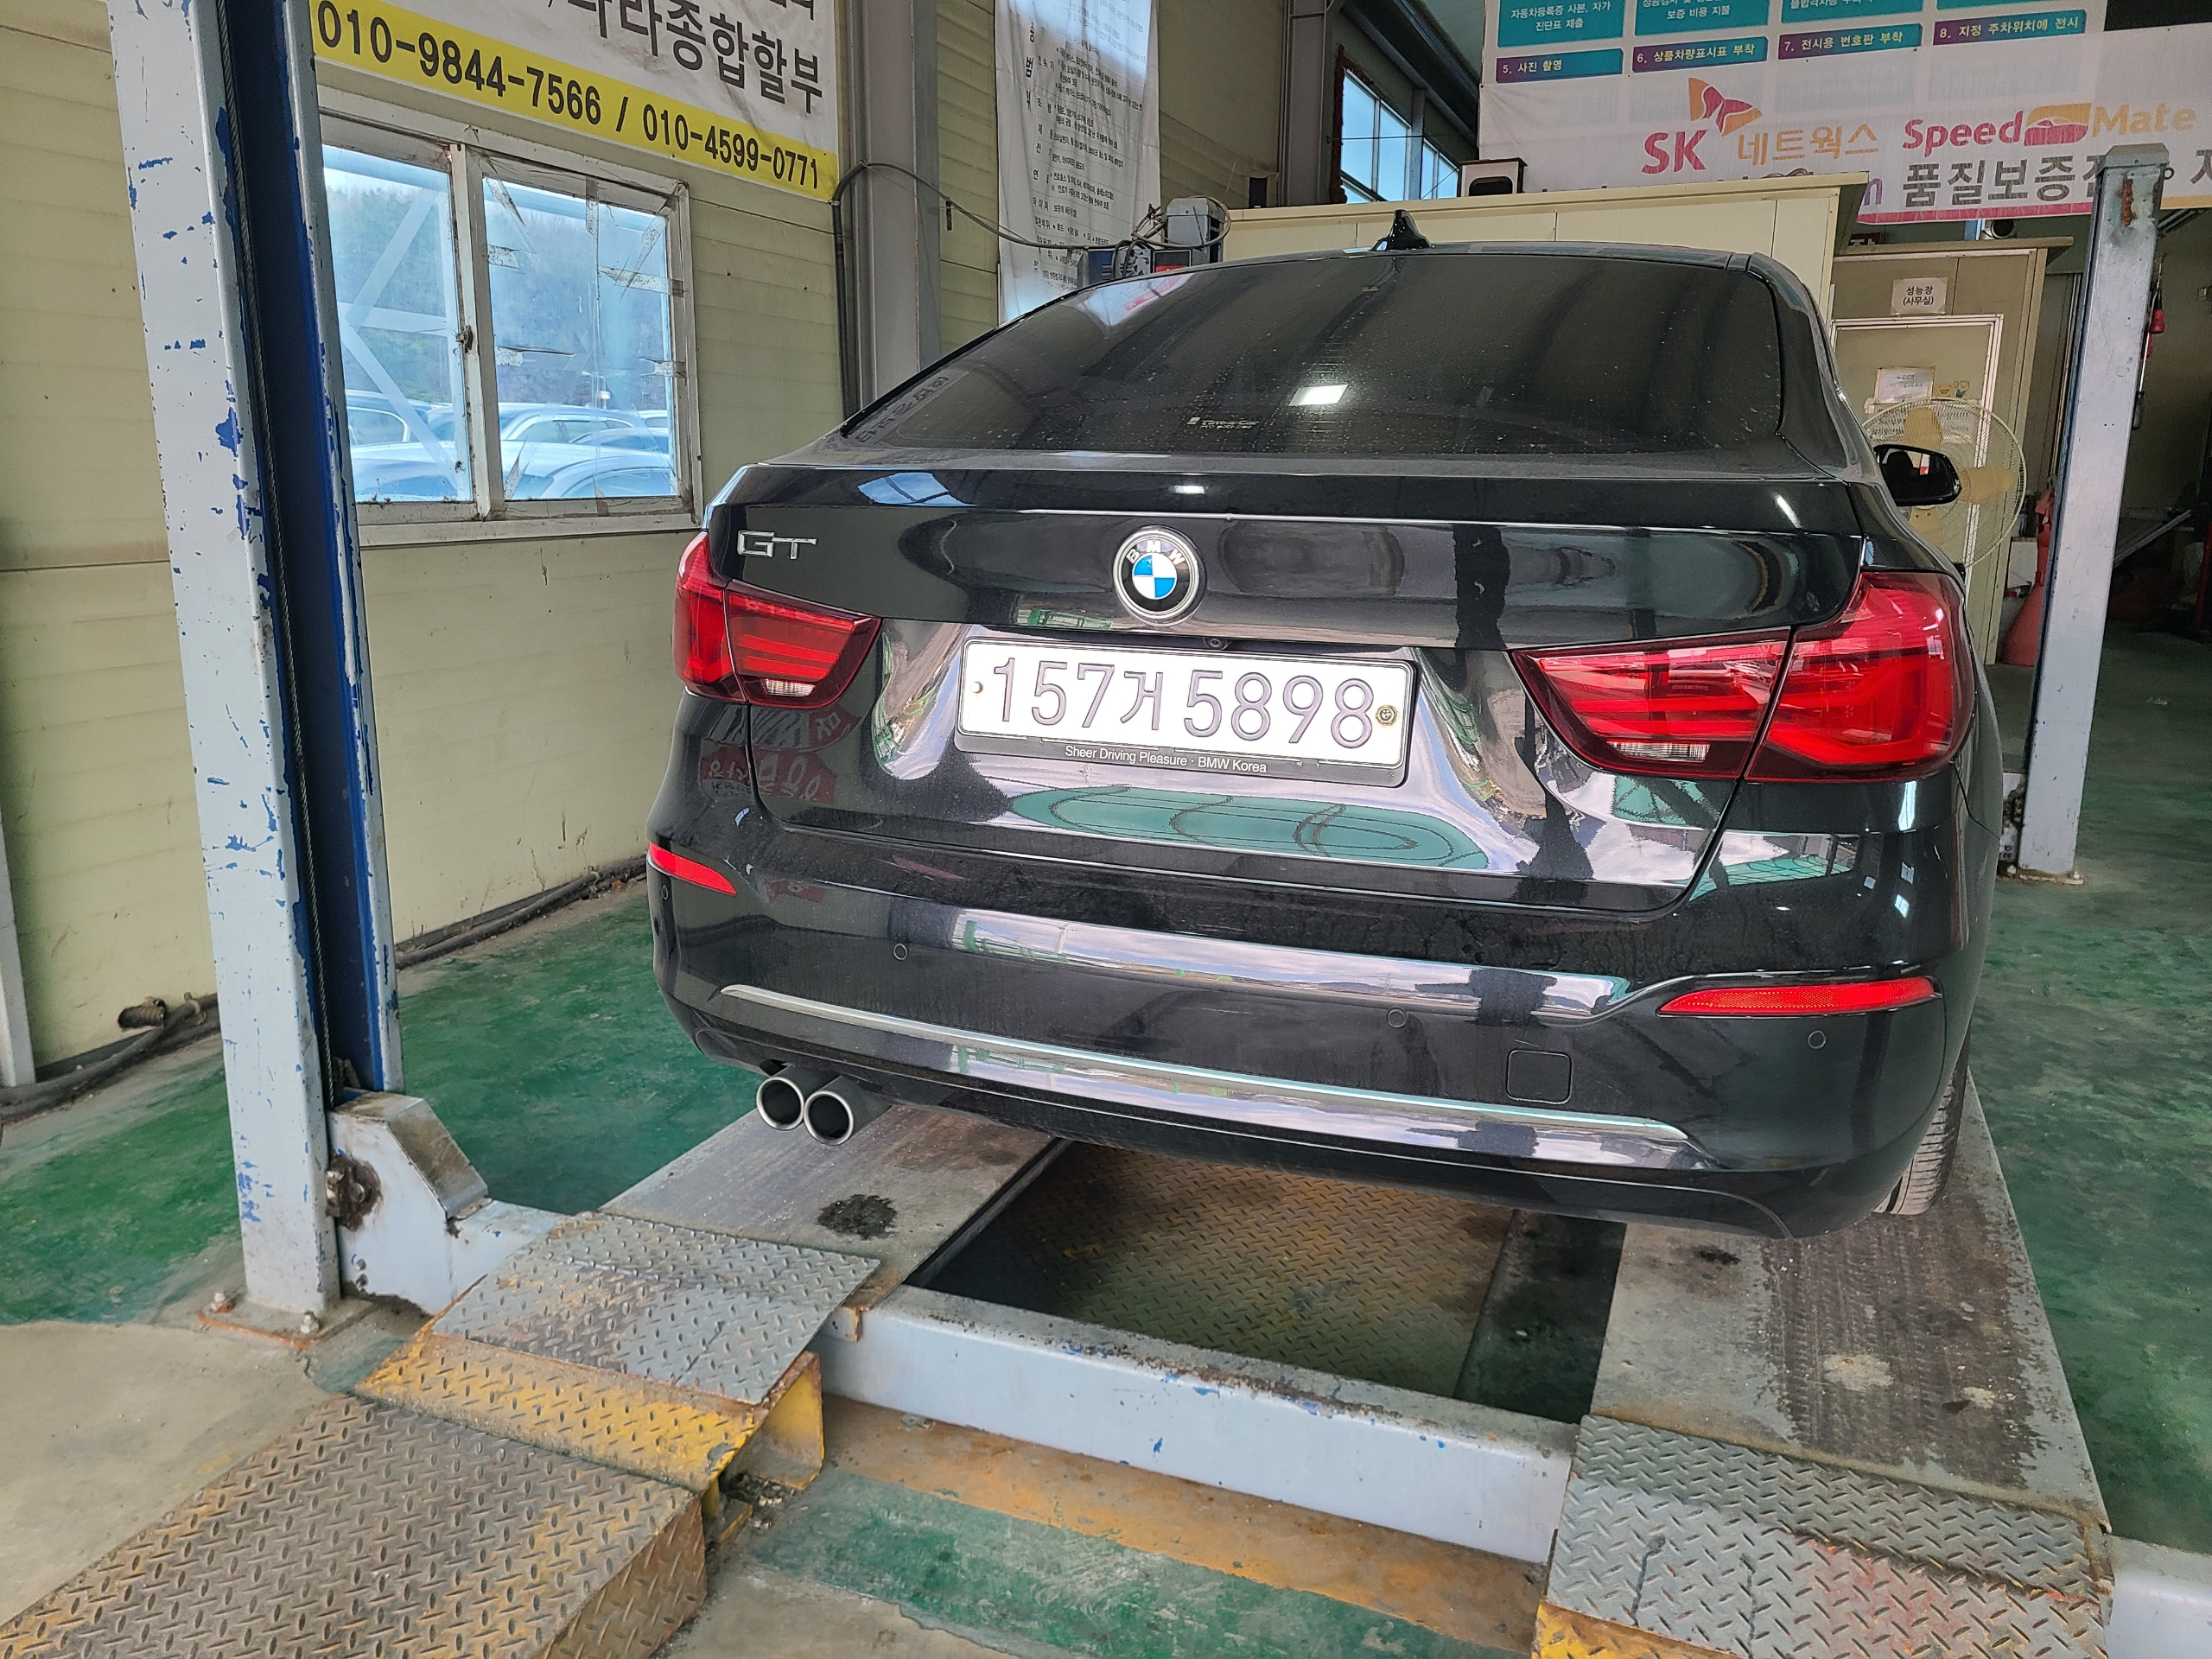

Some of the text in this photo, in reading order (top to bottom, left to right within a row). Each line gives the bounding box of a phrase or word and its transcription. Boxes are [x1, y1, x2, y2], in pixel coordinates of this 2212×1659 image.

[1511, 5, 1564, 19] 자동차등록증
[1592, 1, 1611, 11] 자가
[1667, 9, 1685, 20] 보증
[1689, 7, 1707, 17] 비용
[1535, 17, 1584, 32] 진단표 제출
[1939, 16, 2079, 39] 8. 지정 주차위치에 전시
[1784, 31, 1904, 51] 7. 전시용 번호판 부착
[1637, 43, 1755, 63] 6. 상품차량표시표 부착
[1503, 60, 1562, 74] 5. 사진 촬영
[317, 0, 601, 125] 010-9844-7566
[643, 104, 818, 189] 010-4599-0771
[1902, 103, 2196, 157] Speed Mate
[1641, 124, 1878, 175] SK 네트웍스
[1903, 296, 1934, 306] (사무실)
[1906, 285, 1934, 296] 성능장
[737, 530, 818, 560] GT
[1126, 540, 1185, 564] BMW
[1183, 669, 1374, 749] 5898
[1065, 745, 1268, 773] Sheer Driving Pleasure BMW Korea
